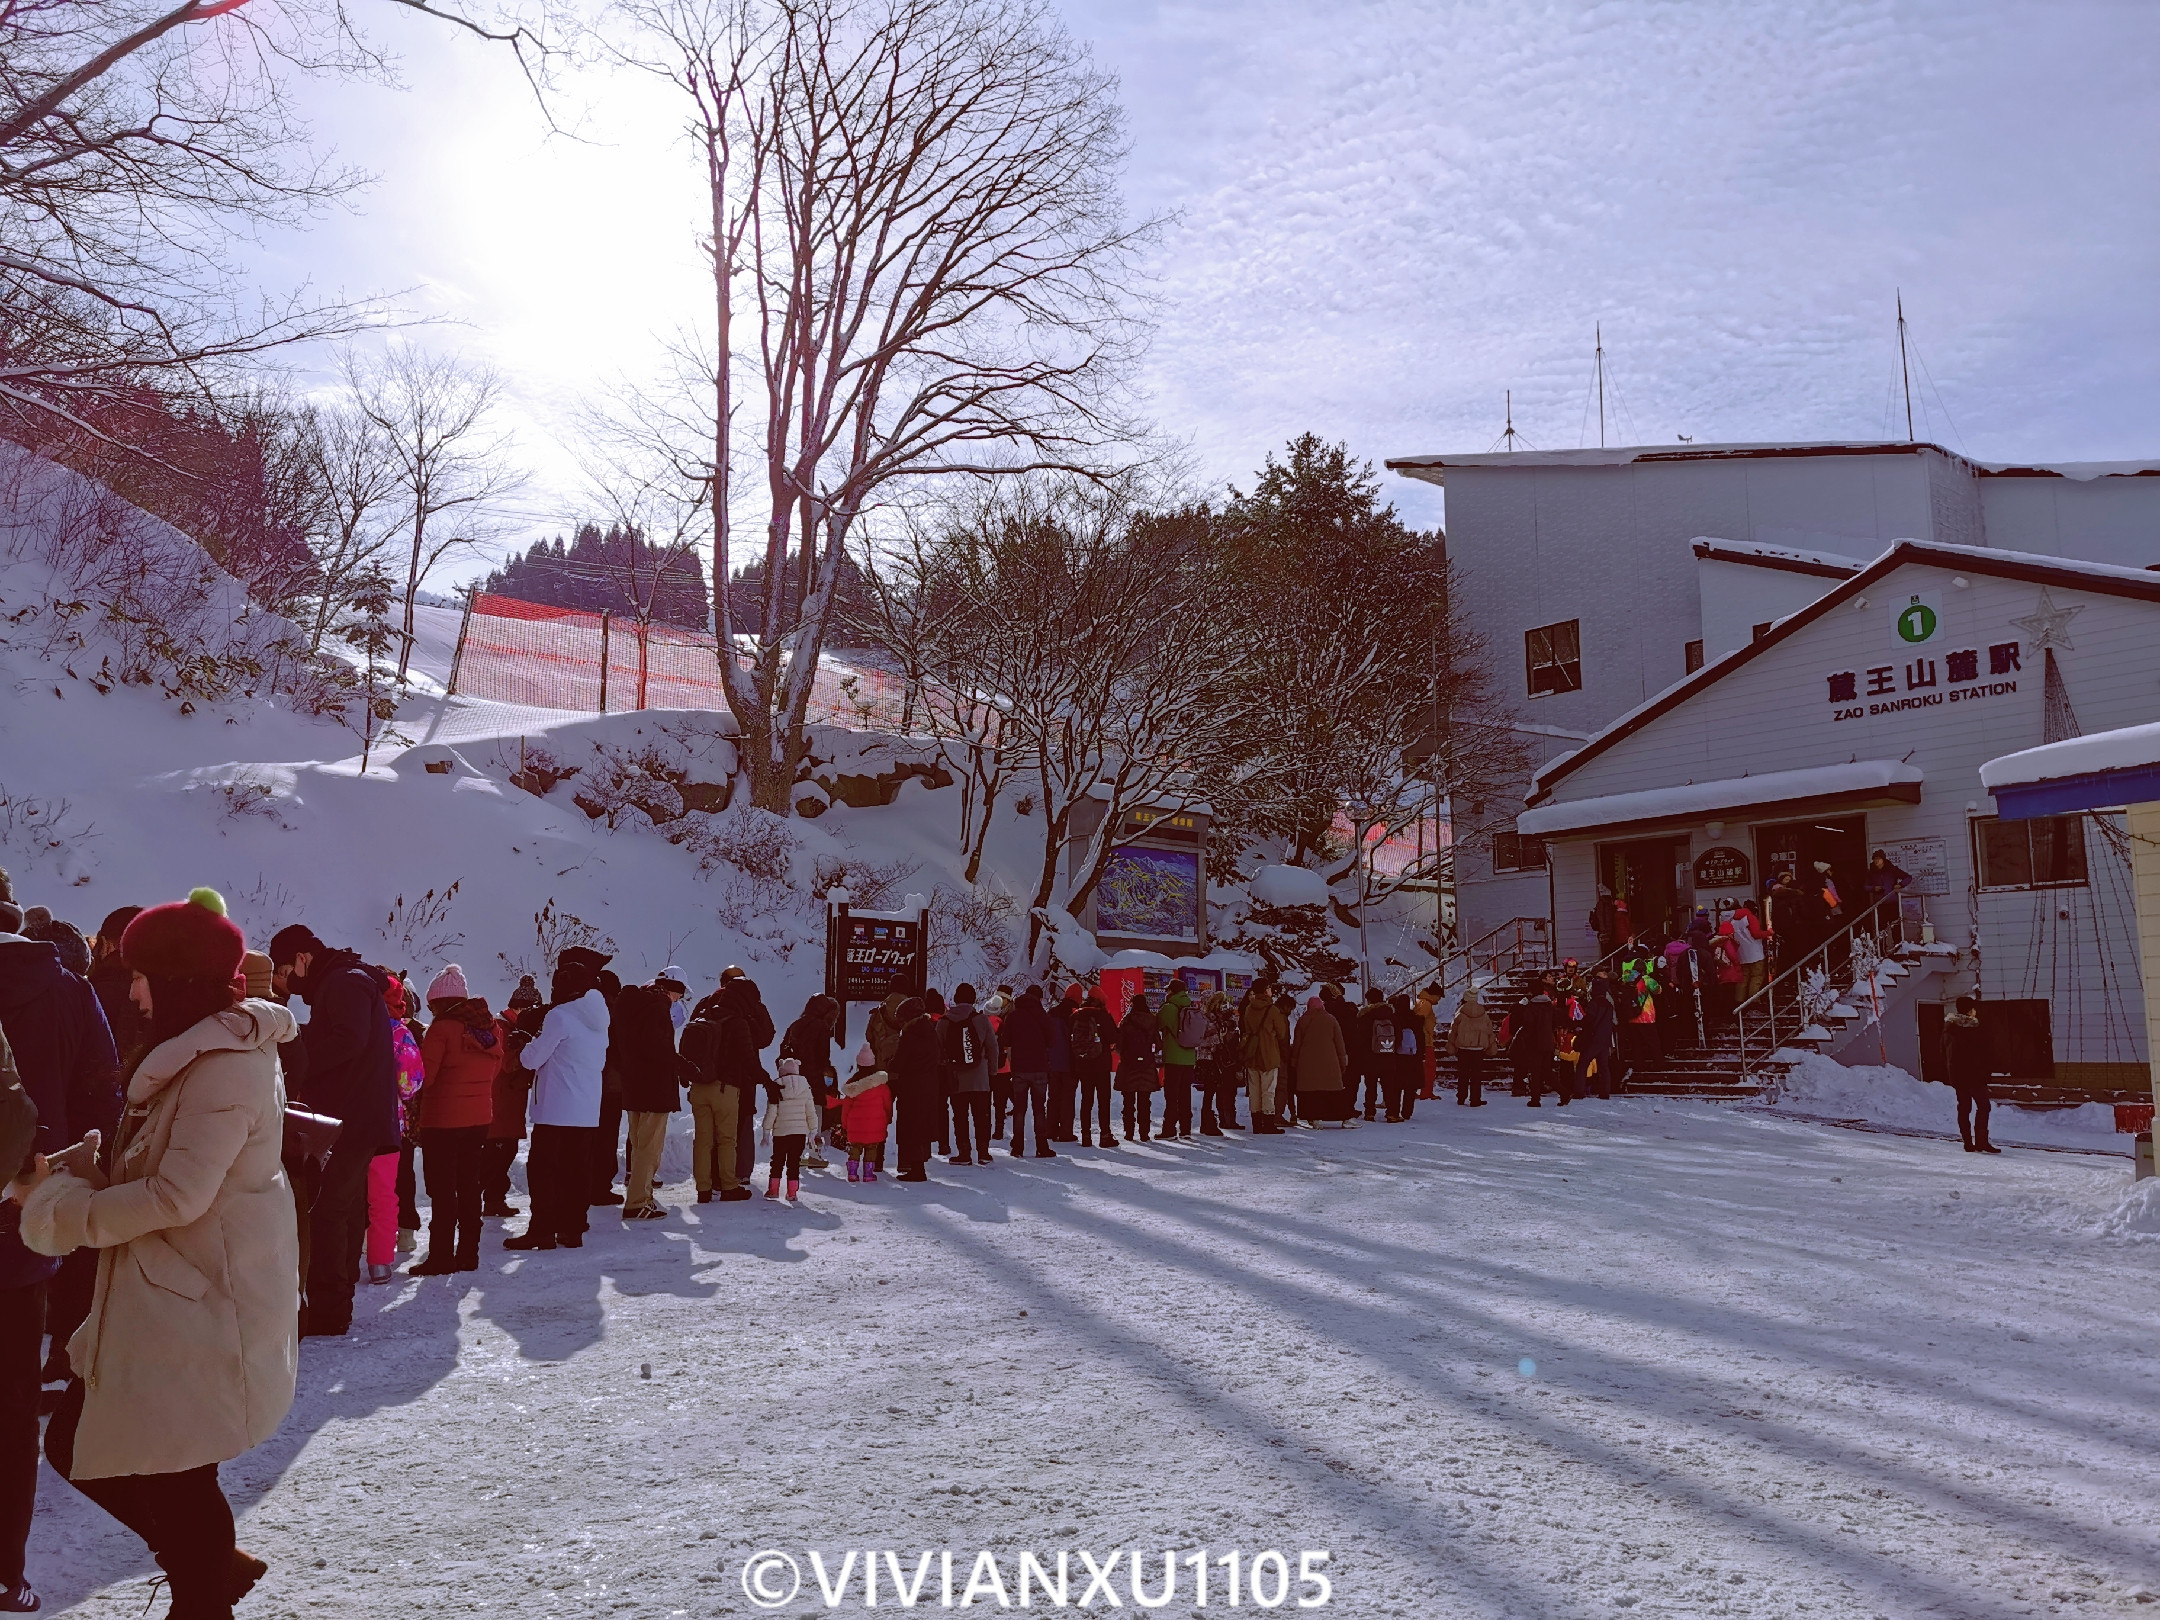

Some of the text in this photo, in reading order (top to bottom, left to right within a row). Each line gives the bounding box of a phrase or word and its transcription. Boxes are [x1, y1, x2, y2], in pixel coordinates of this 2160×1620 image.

[1907, 611, 1924, 636] 1
[1833, 681, 2017, 722] ZAO SANROKU STATION
